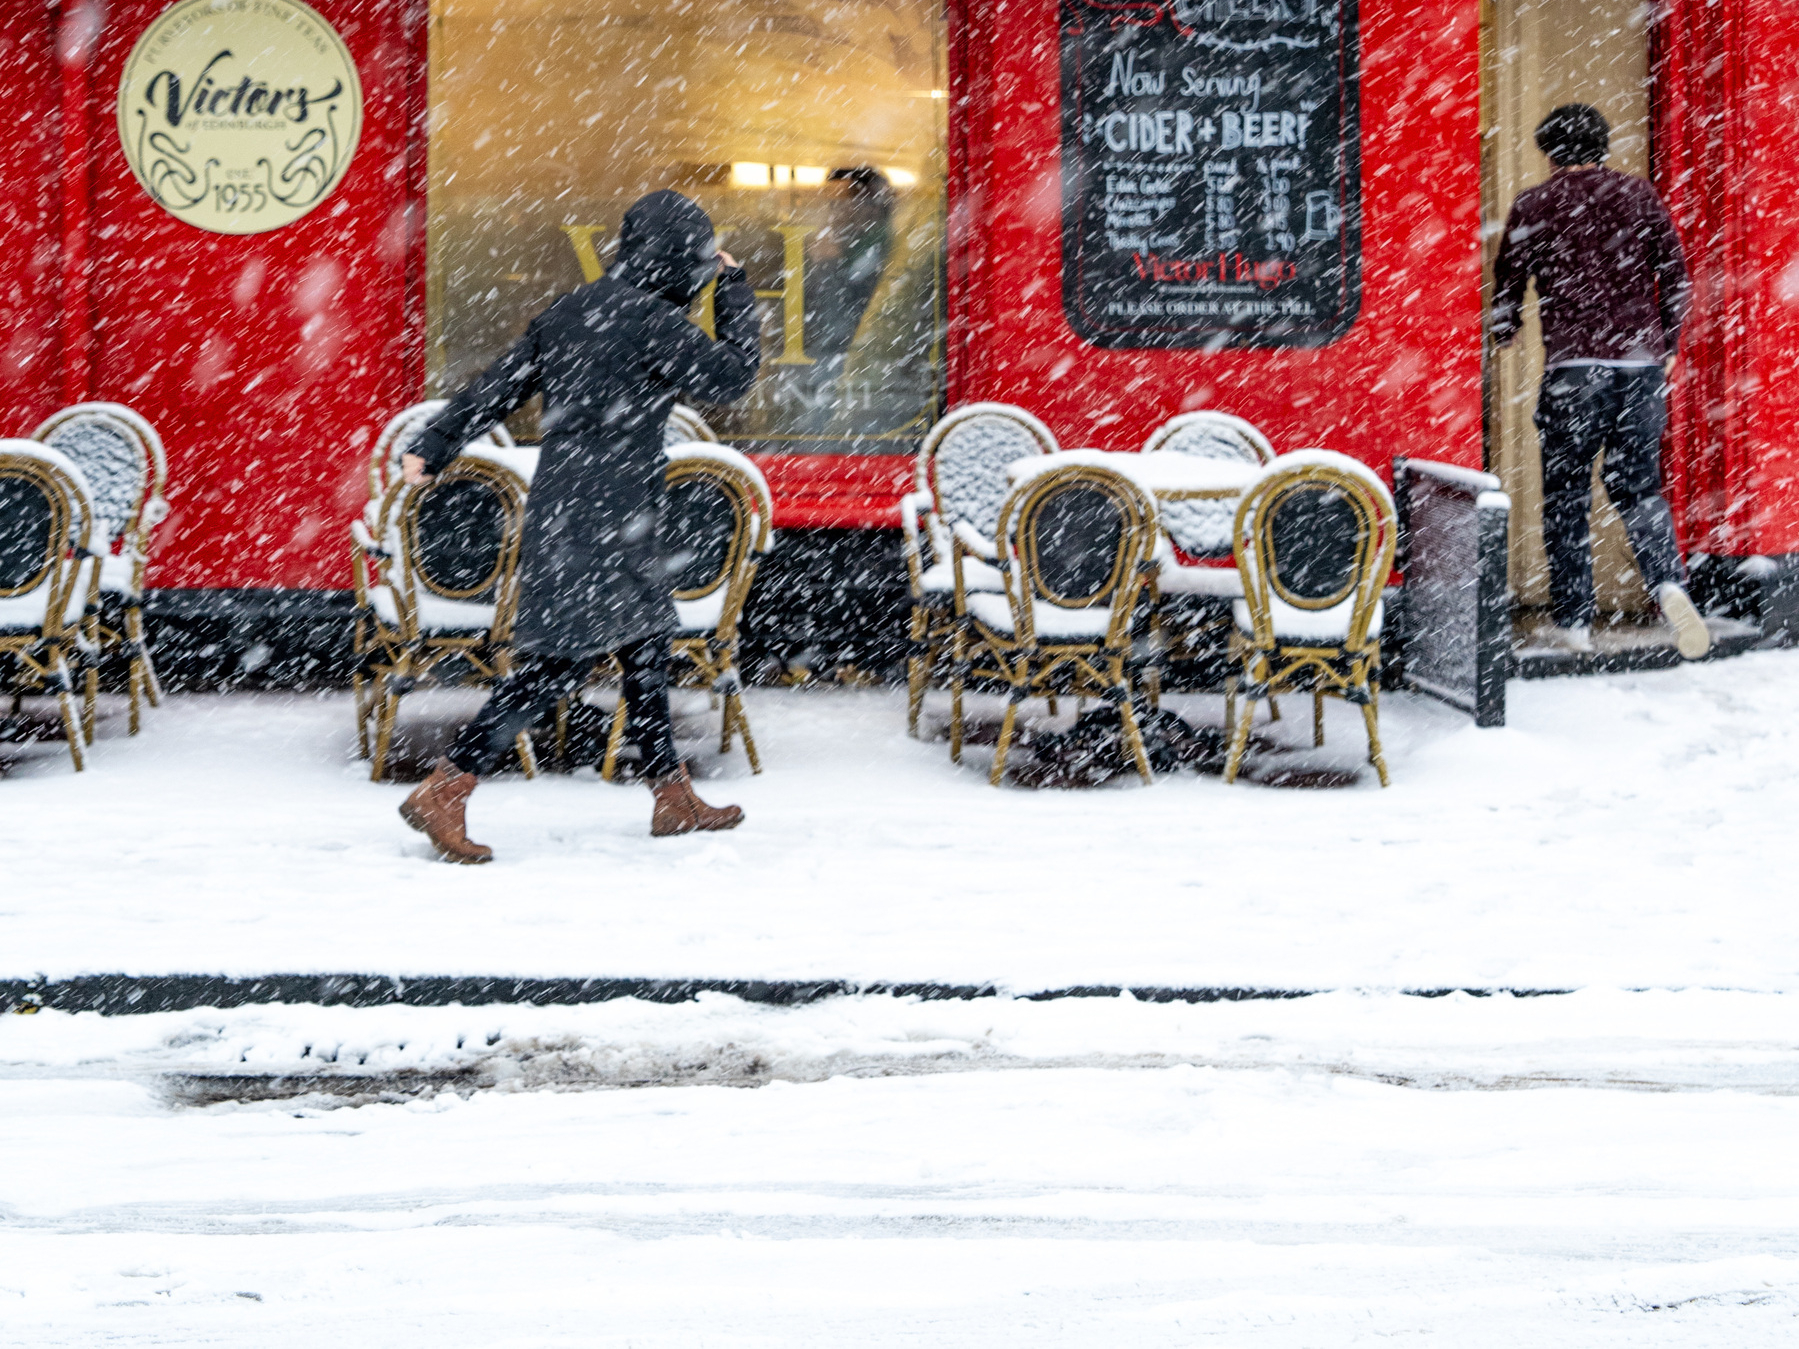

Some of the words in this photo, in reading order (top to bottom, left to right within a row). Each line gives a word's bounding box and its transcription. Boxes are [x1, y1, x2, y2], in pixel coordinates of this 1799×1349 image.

[1102, 49, 1166, 98] Now
[1179, 65, 1263, 116] Serving
[1104, 109, 1194, 155] CIDER
[214, 183, 267, 213] 1955
